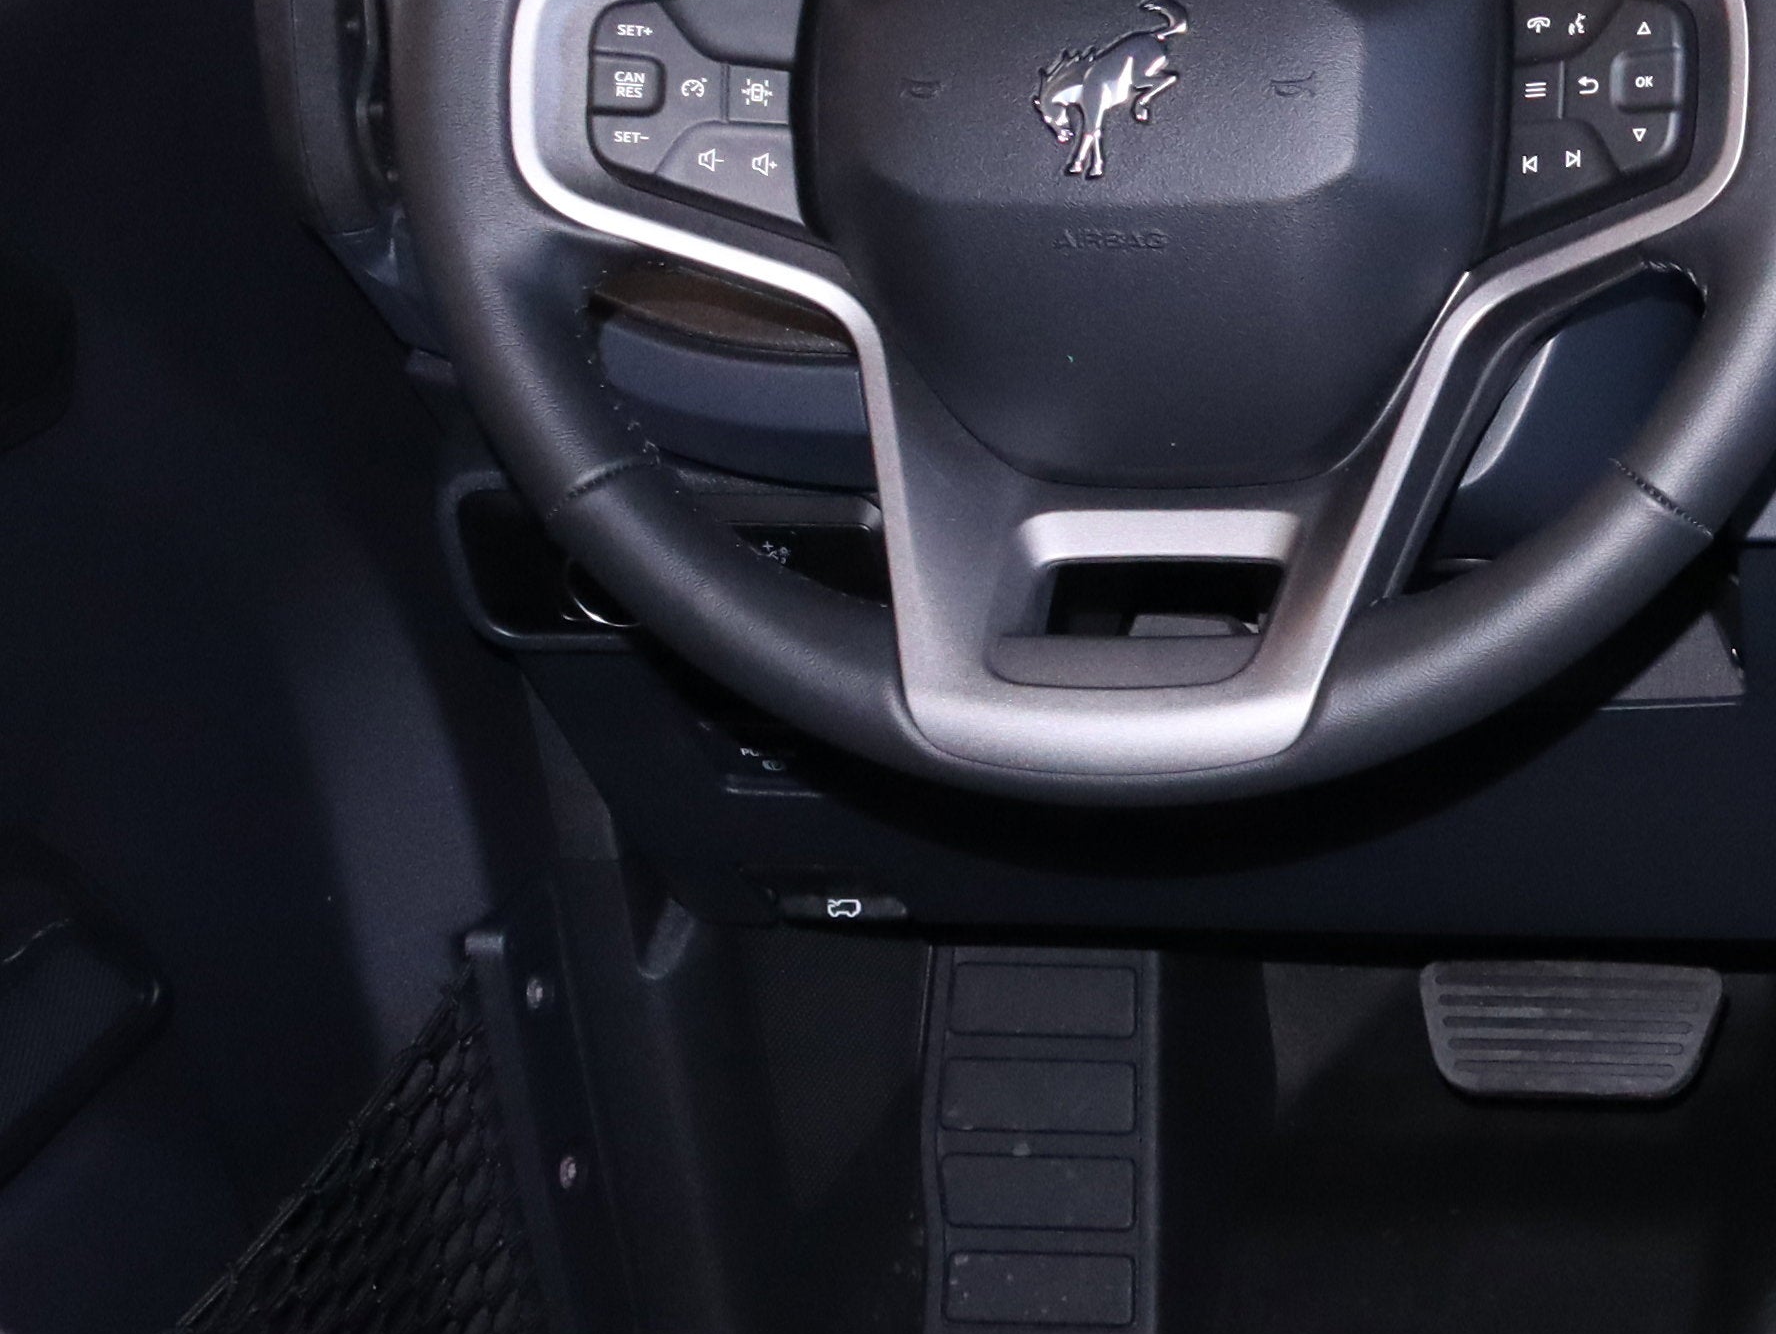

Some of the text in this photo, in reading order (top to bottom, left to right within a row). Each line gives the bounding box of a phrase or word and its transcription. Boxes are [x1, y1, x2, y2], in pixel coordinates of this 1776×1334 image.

[617, 24, 653, 37] SET+
[614, 71, 645, 83] CAN
[1635, 75, 1653, 88] OK
[615, 86, 643, 98] RES
